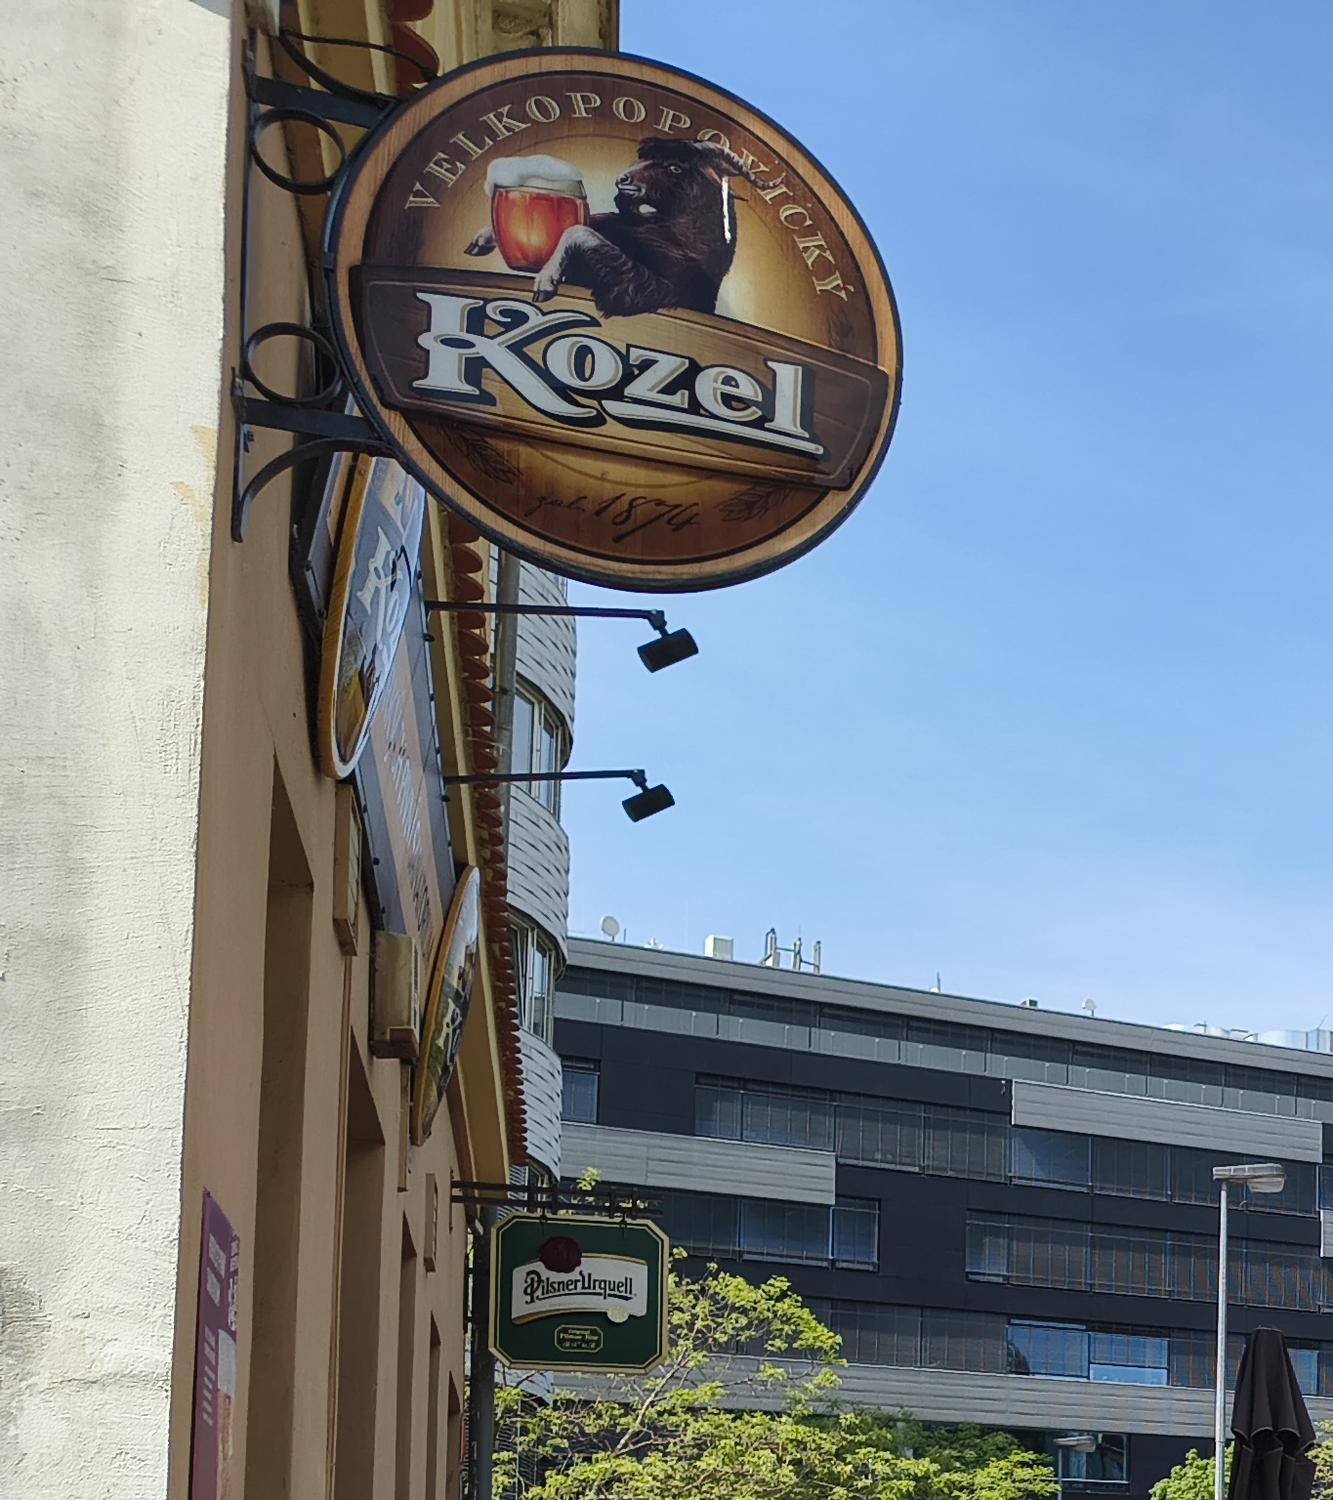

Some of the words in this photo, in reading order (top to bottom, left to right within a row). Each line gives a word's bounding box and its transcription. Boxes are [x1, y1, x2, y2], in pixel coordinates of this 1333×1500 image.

[412, 291, 823, 455] Kozel
[594, 492, 700, 545] 1874
[523, 1269, 582, 1304] Pilsner
[579, 1270, 633, 1300] Urquell
